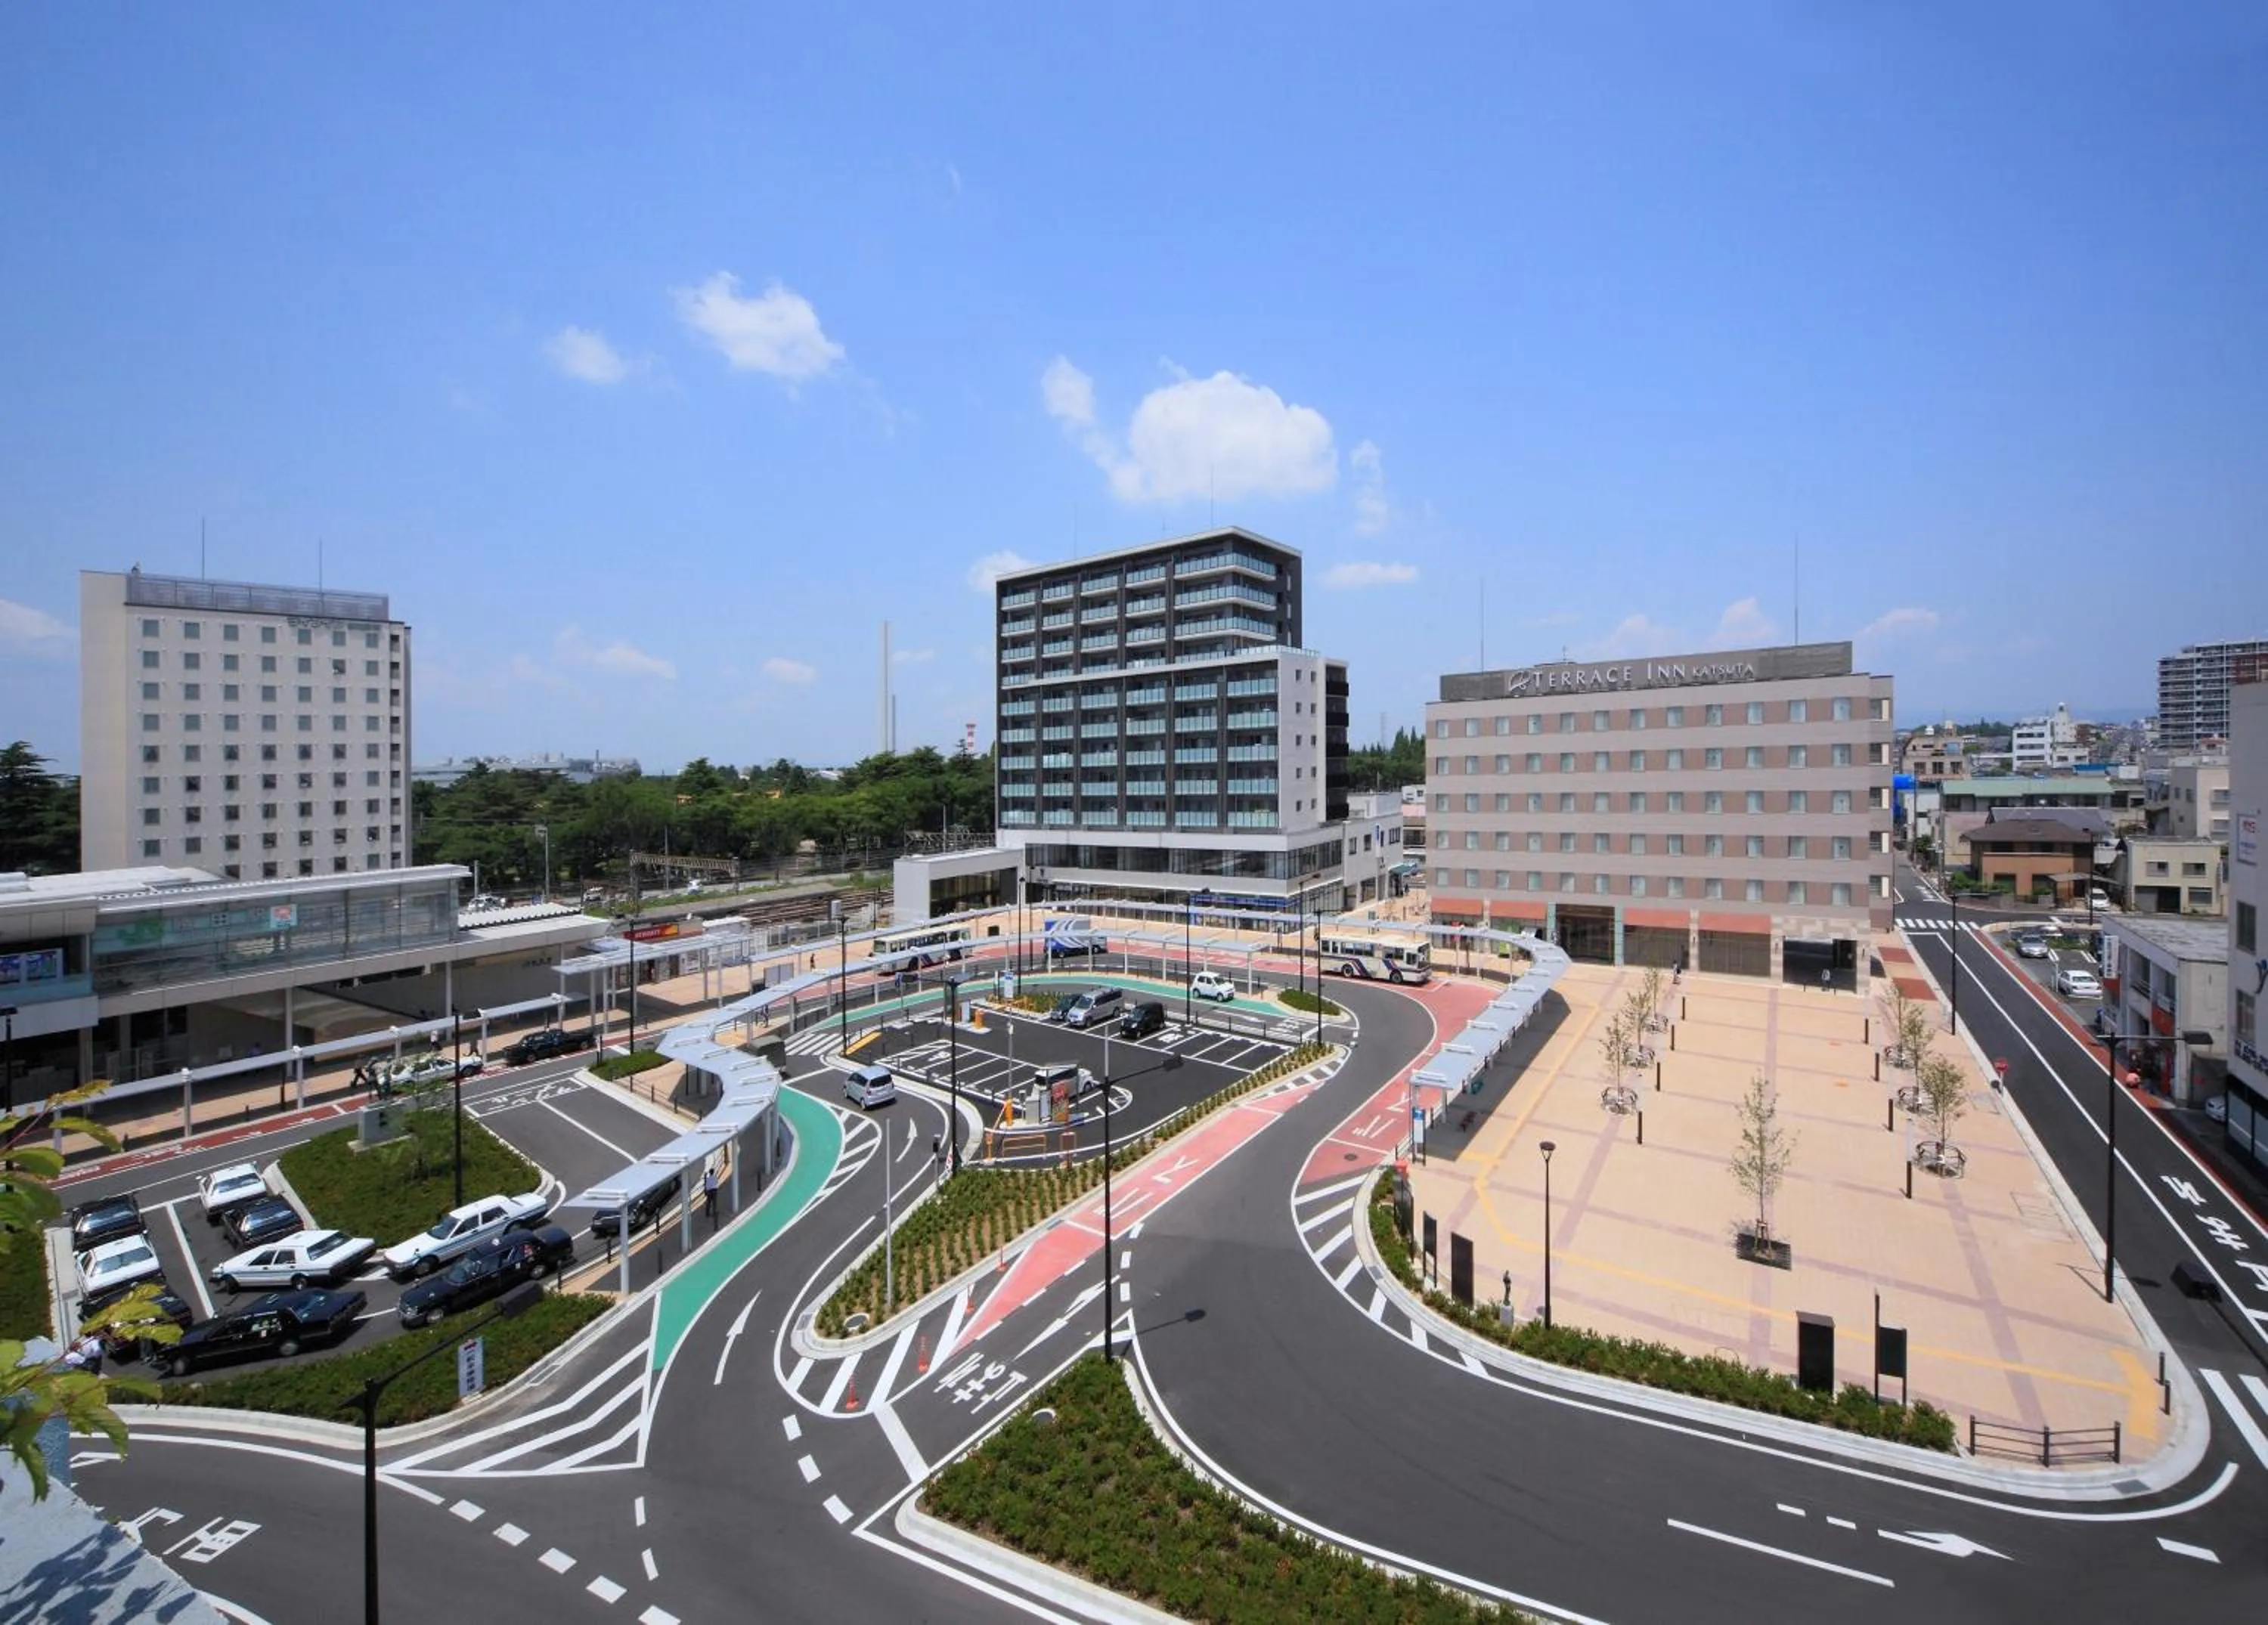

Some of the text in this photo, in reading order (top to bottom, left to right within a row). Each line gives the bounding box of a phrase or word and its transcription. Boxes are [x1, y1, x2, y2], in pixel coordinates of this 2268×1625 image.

[1533, 662, 1754, 687] TERRACE INN KATSUTA
